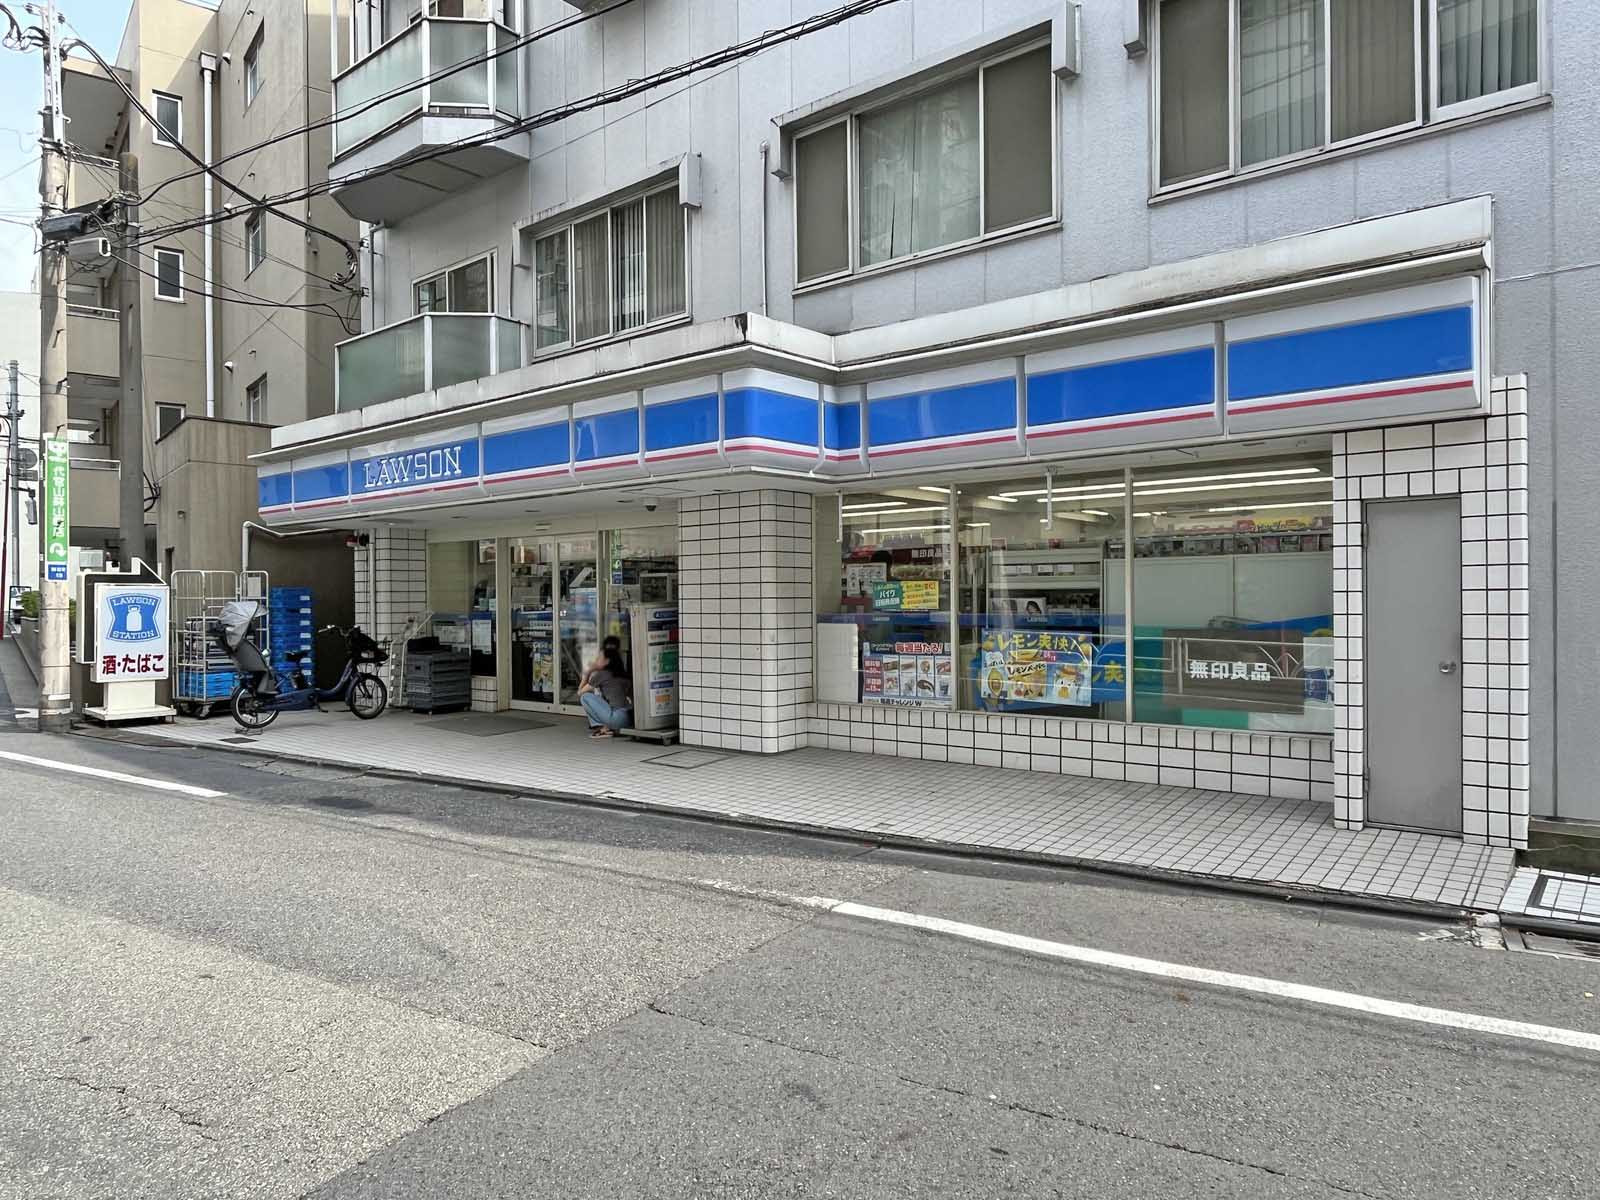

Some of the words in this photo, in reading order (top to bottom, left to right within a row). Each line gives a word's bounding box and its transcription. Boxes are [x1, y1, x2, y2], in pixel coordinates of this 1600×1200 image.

[364, 446, 461, 488] LAWSON
[112, 596, 156, 606] LAWSON
[112, 630, 154, 640] STATION
[1190, 661, 1271, 681] 無印良品
